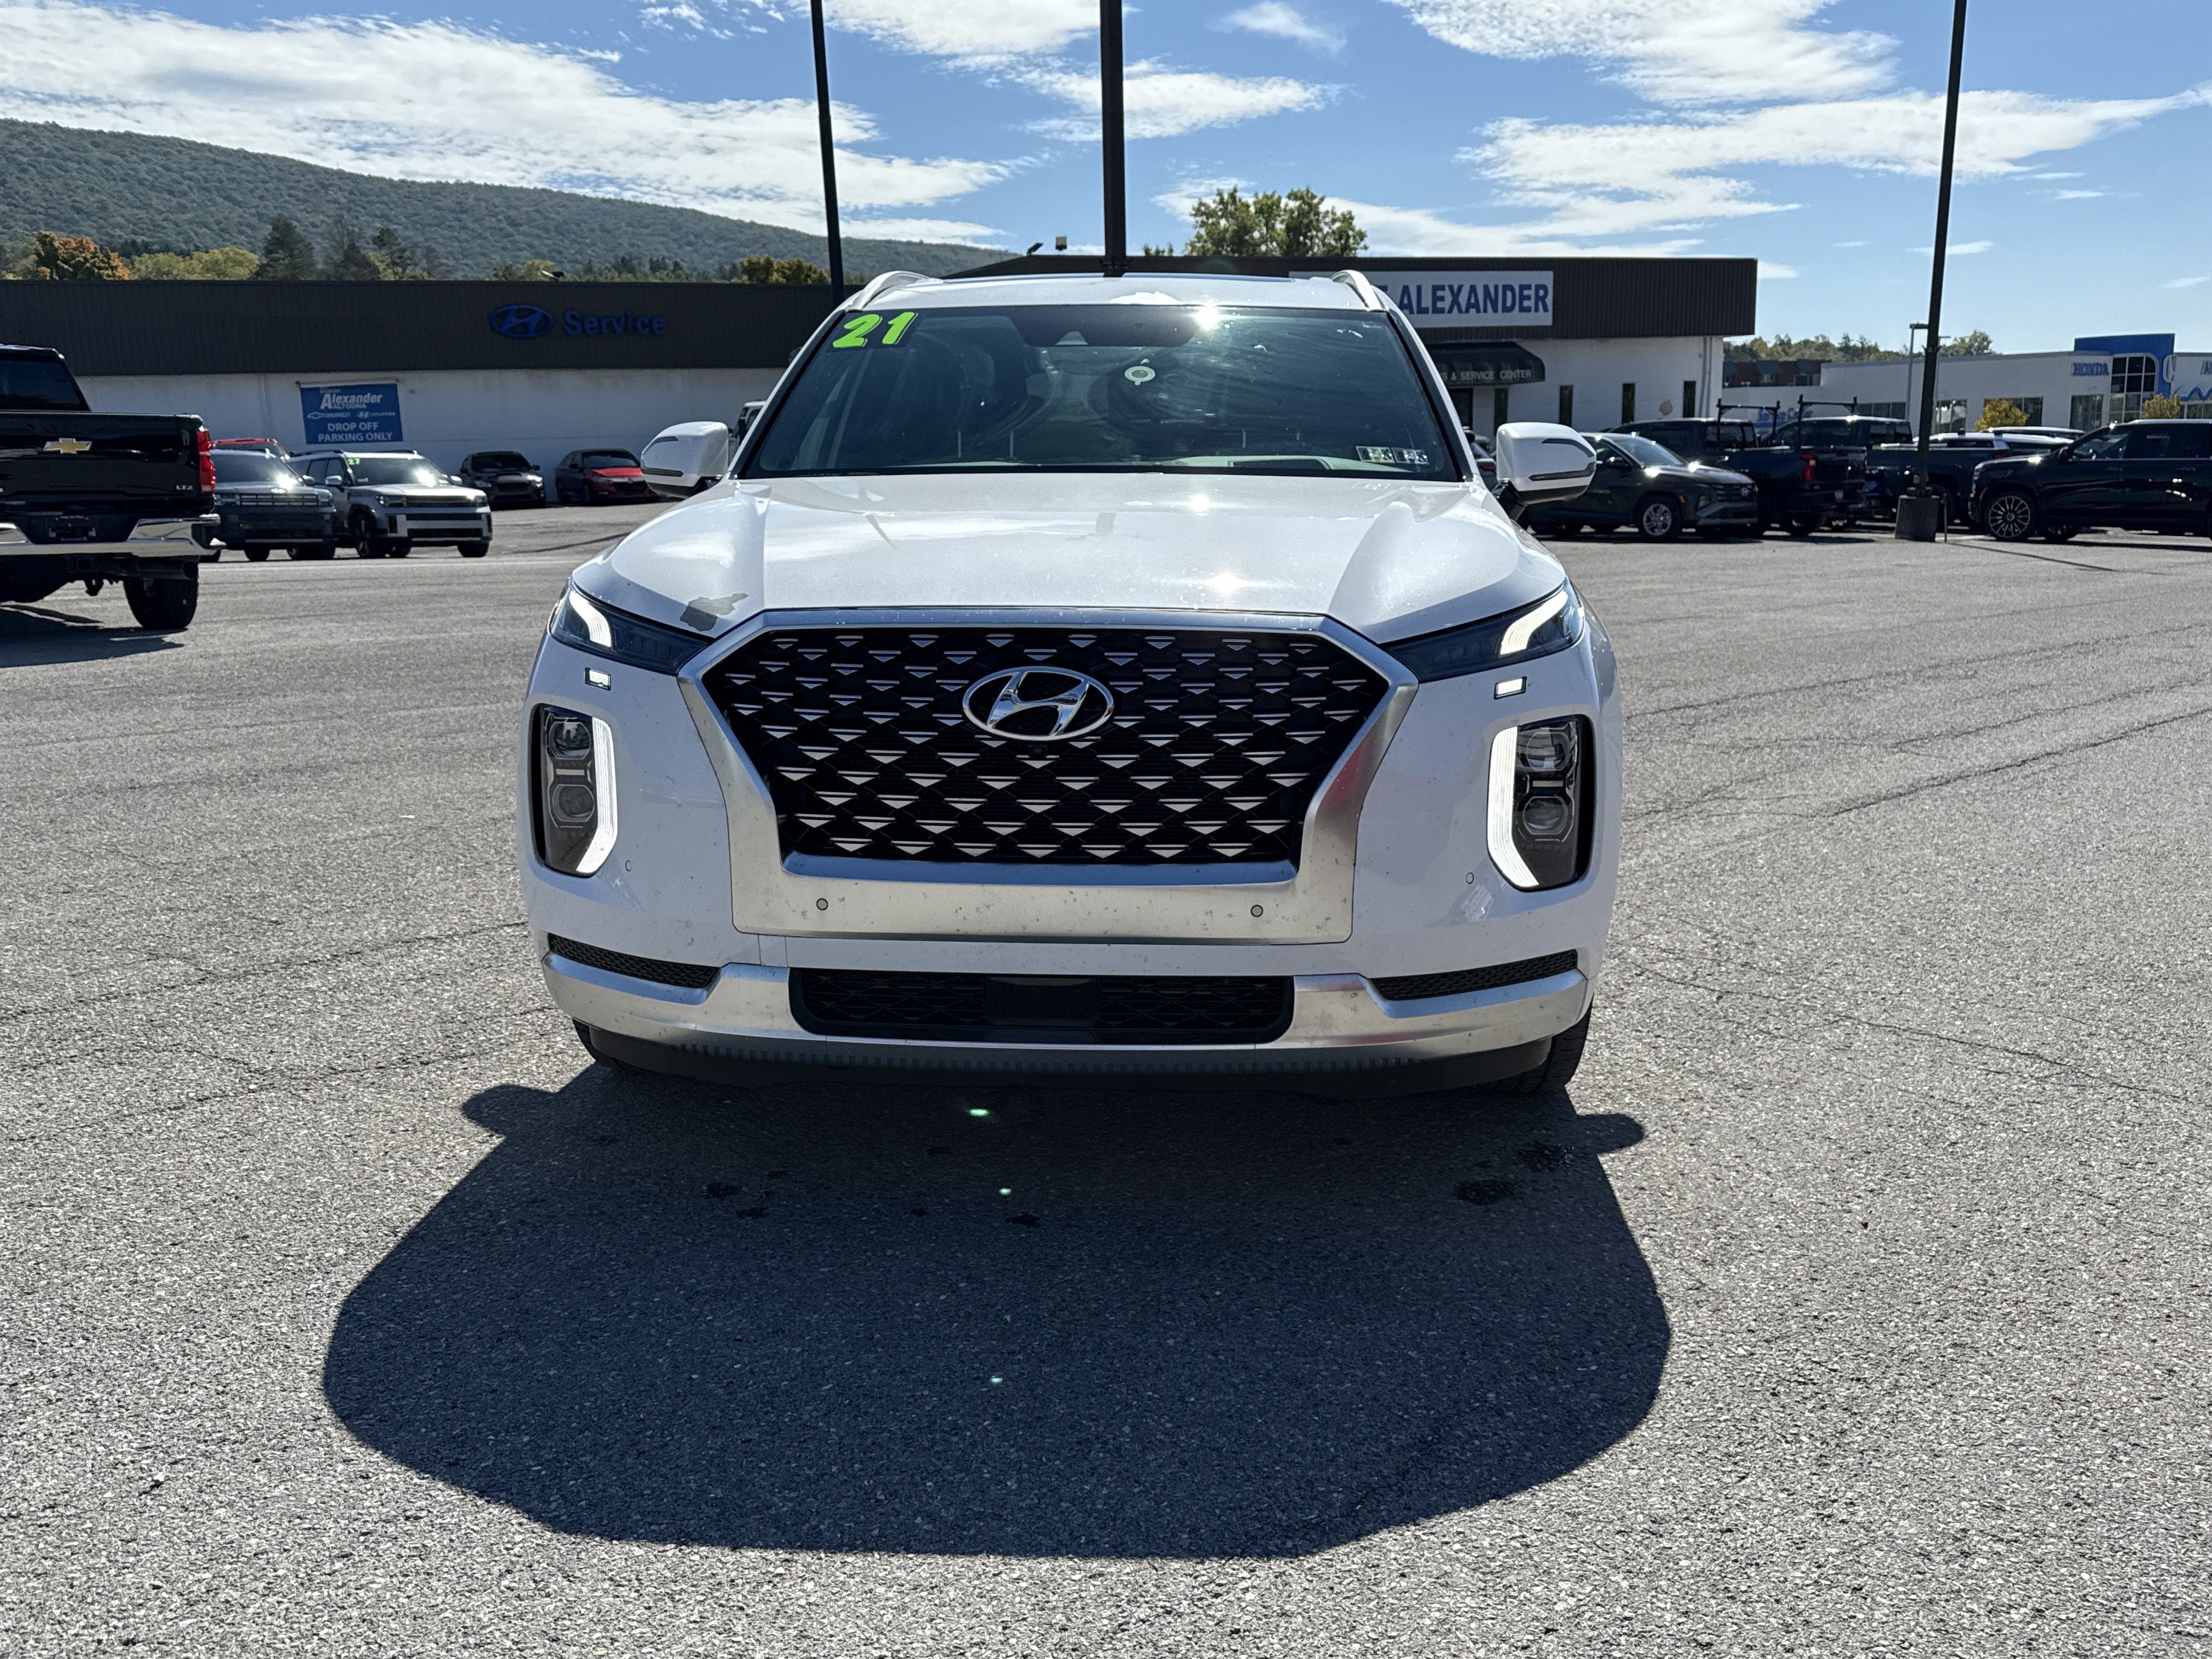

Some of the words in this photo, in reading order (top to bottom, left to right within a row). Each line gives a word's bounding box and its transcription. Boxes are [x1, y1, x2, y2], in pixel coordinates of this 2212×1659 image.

[1399, 284, 1549, 314] ALEXANDER
[563, 309, 667, 335] Service
[832, 311, 919, 348] 21
[1460, 370, 1495, 381] SERVICE
[1499, 370, 1532, 380] CENTER
[2072, 362, 2109, 376] HONDA
[320, 393, 383, 409] Alexander
[328, 422, 357, 431] DROP
[359, 421, 379, 431] OFF
[318, 433, 364, 442] PARKING
[365, 431, 393, 441] ONLY
